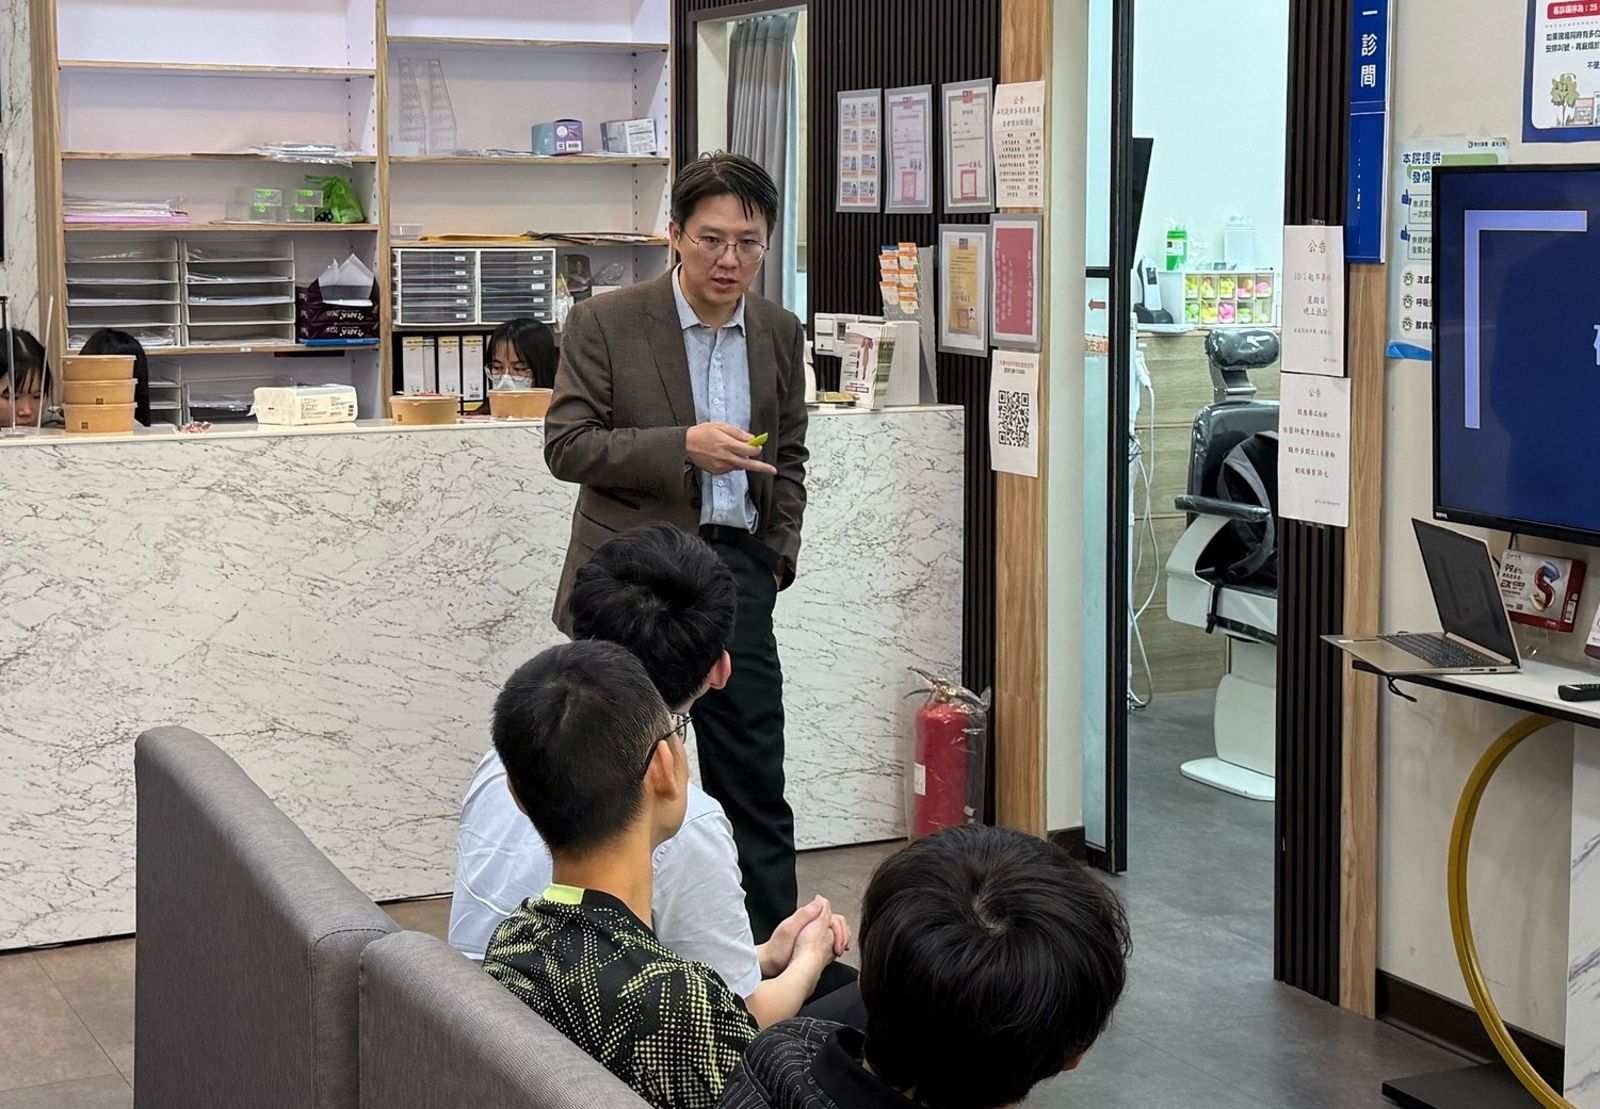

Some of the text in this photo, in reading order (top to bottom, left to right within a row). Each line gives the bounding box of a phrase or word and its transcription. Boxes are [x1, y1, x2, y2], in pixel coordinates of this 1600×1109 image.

[1361, 10, 1378, 88] 一診間
[1402, 152, 1441, 165] 本院提供
[1308, 239, 1327, 254] 公告
[1309, 388, 1321, 398] 公告
